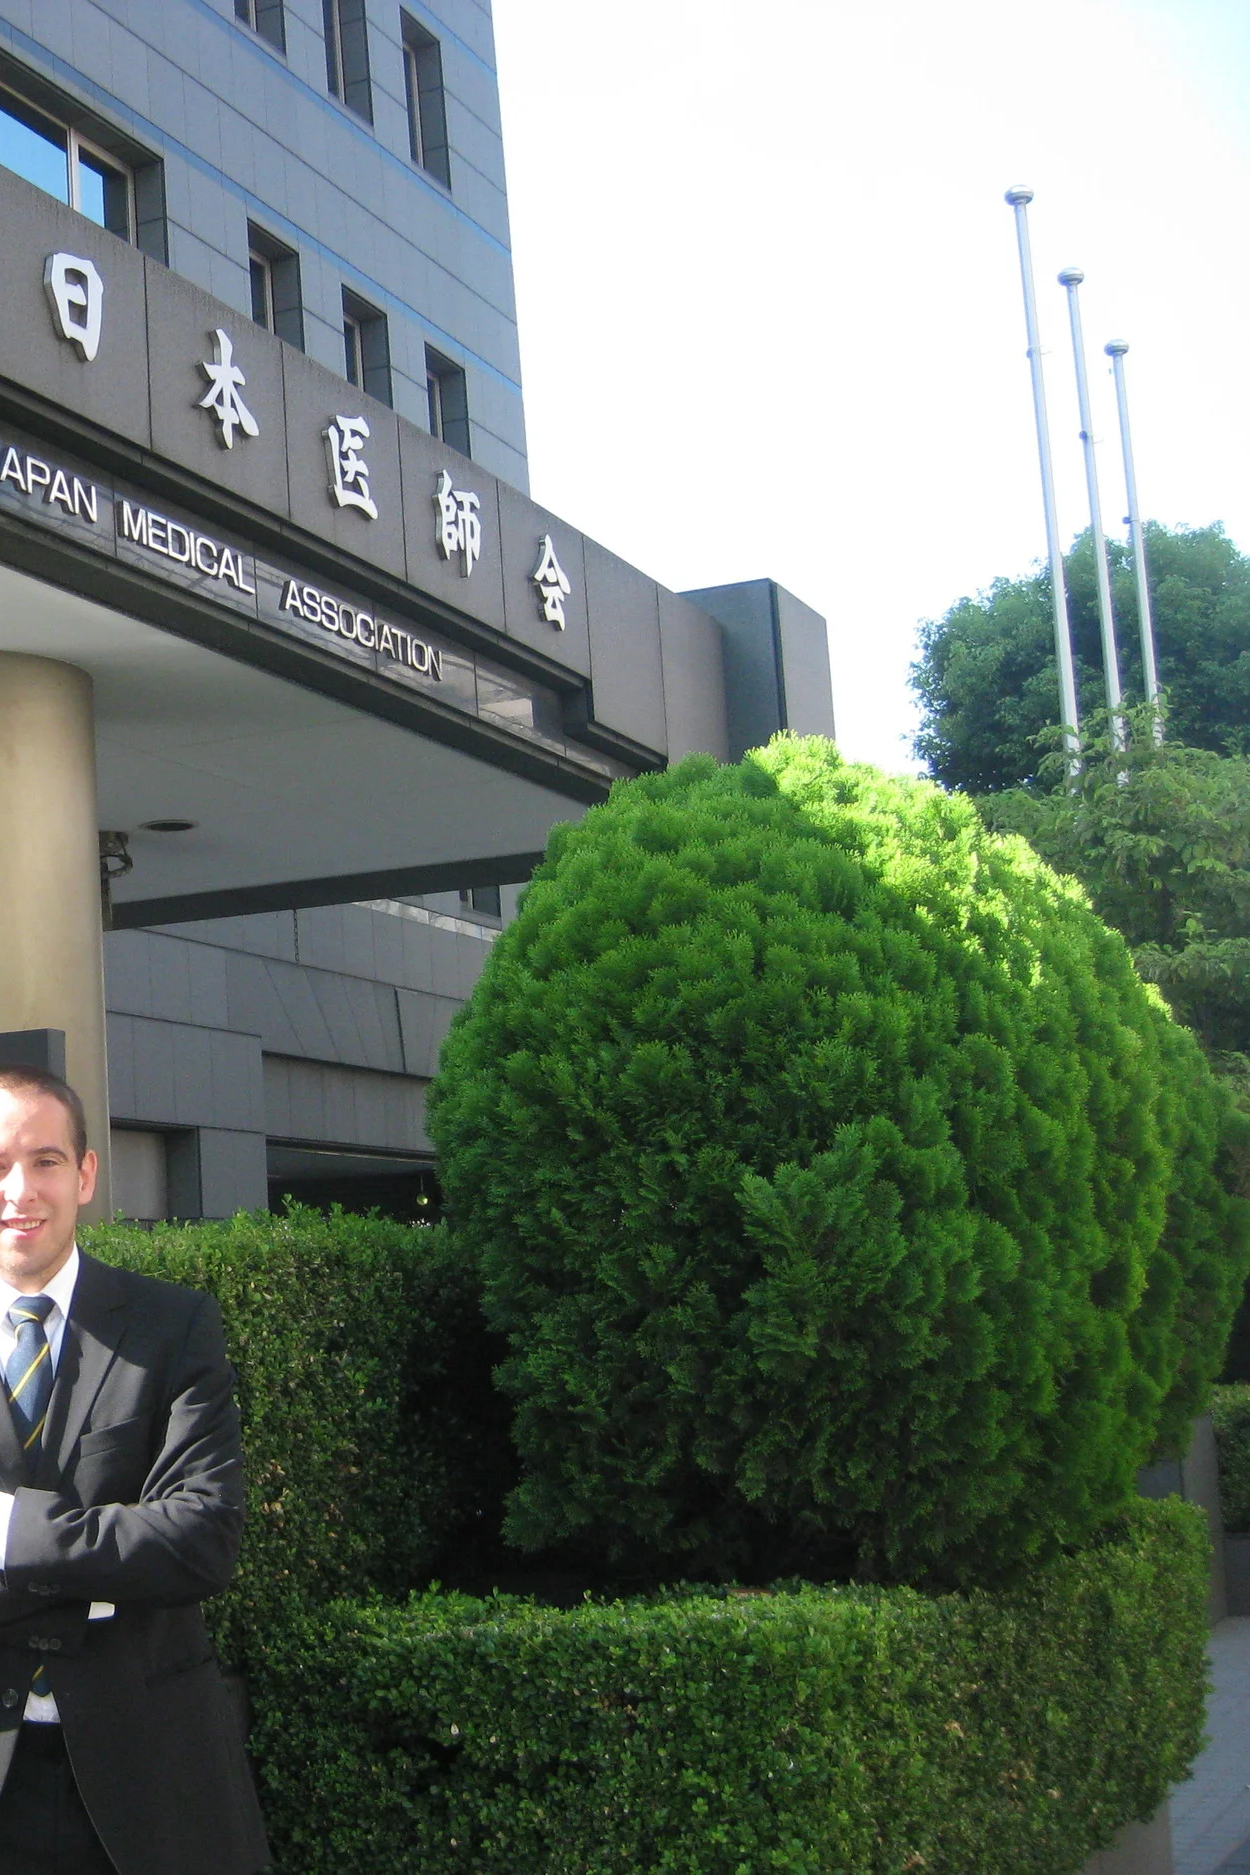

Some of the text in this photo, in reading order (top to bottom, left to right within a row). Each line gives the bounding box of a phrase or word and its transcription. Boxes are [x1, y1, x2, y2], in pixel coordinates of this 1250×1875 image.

[46, 252, 572, 631] 日本医師会
[122, 500, 256, 595] MEDICAL
[285, 580, 443, 681] ASSOCIATION
